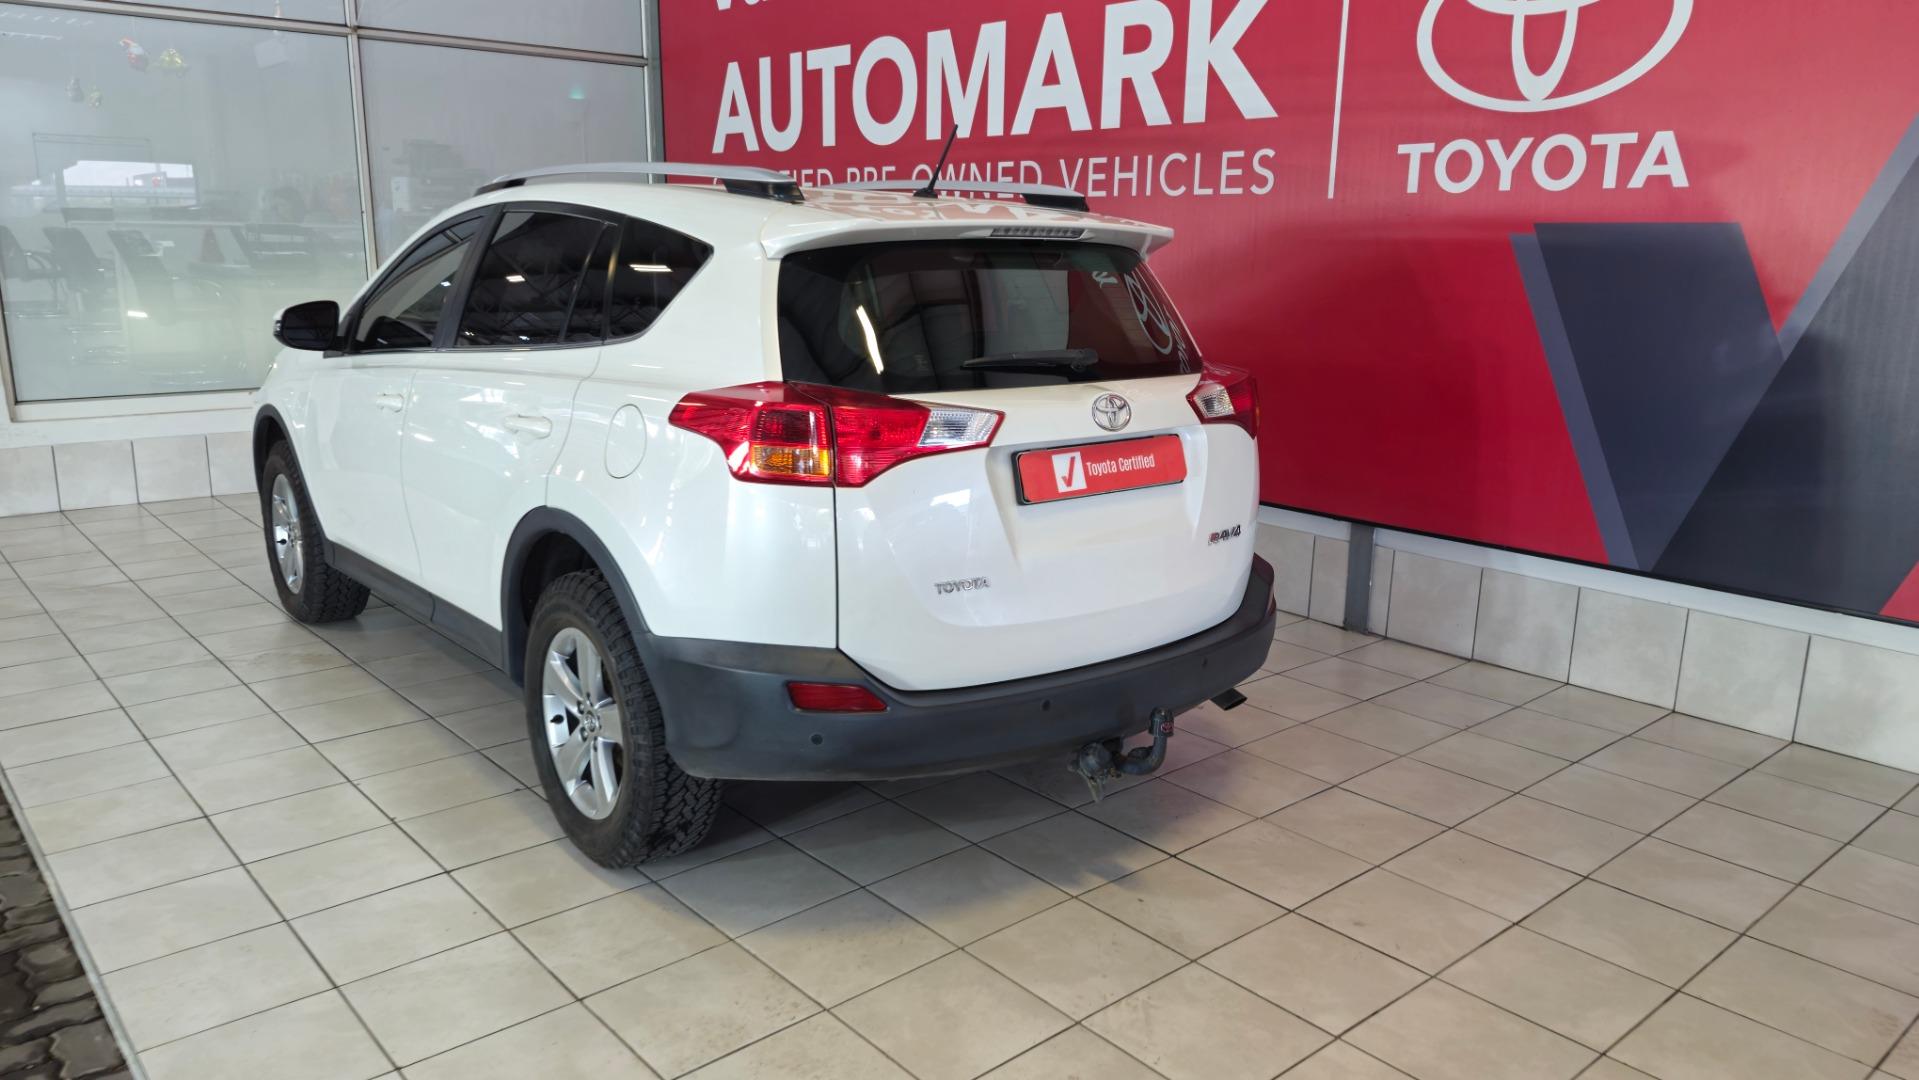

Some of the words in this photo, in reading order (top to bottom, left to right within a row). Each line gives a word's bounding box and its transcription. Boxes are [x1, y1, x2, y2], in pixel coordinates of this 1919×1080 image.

[712, 0, 1279, 154] AUTOMARK
[1059, 148, 1277, 198] VEHICLES
[1397, 130, 1690, 194] TOYOTA
[1086, 460, 1117, 477] Toyota
[1118, 453, 1156, 472] Certified
[934, 576, 991, 595] TOYOTA
